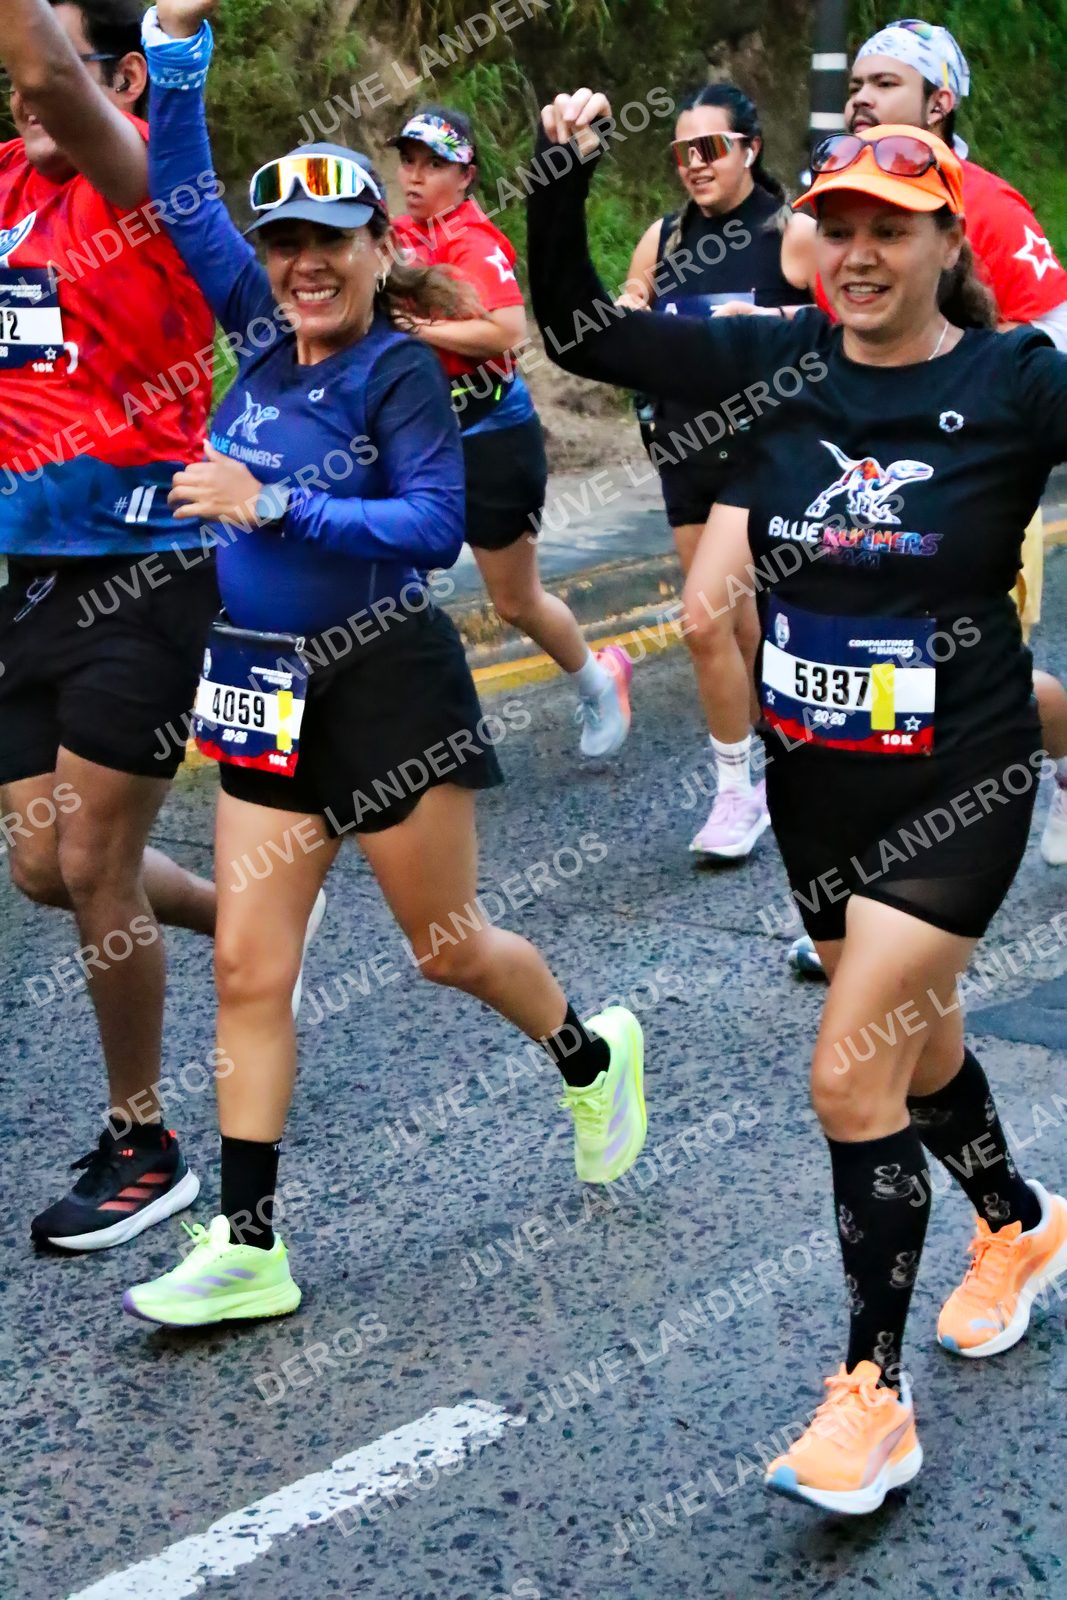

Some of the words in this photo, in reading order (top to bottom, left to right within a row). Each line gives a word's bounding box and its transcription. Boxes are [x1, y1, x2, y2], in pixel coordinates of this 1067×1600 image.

[229, 442, 285, 469] RUNNERS
[768, 516, 825, 542] BLUE
[822, 526, 944, 556] RUNNERS
[795, 661, 871, 707] 5337
[212, 687, 265, 728] 4059
[881, 734, 914, 746] 10K
